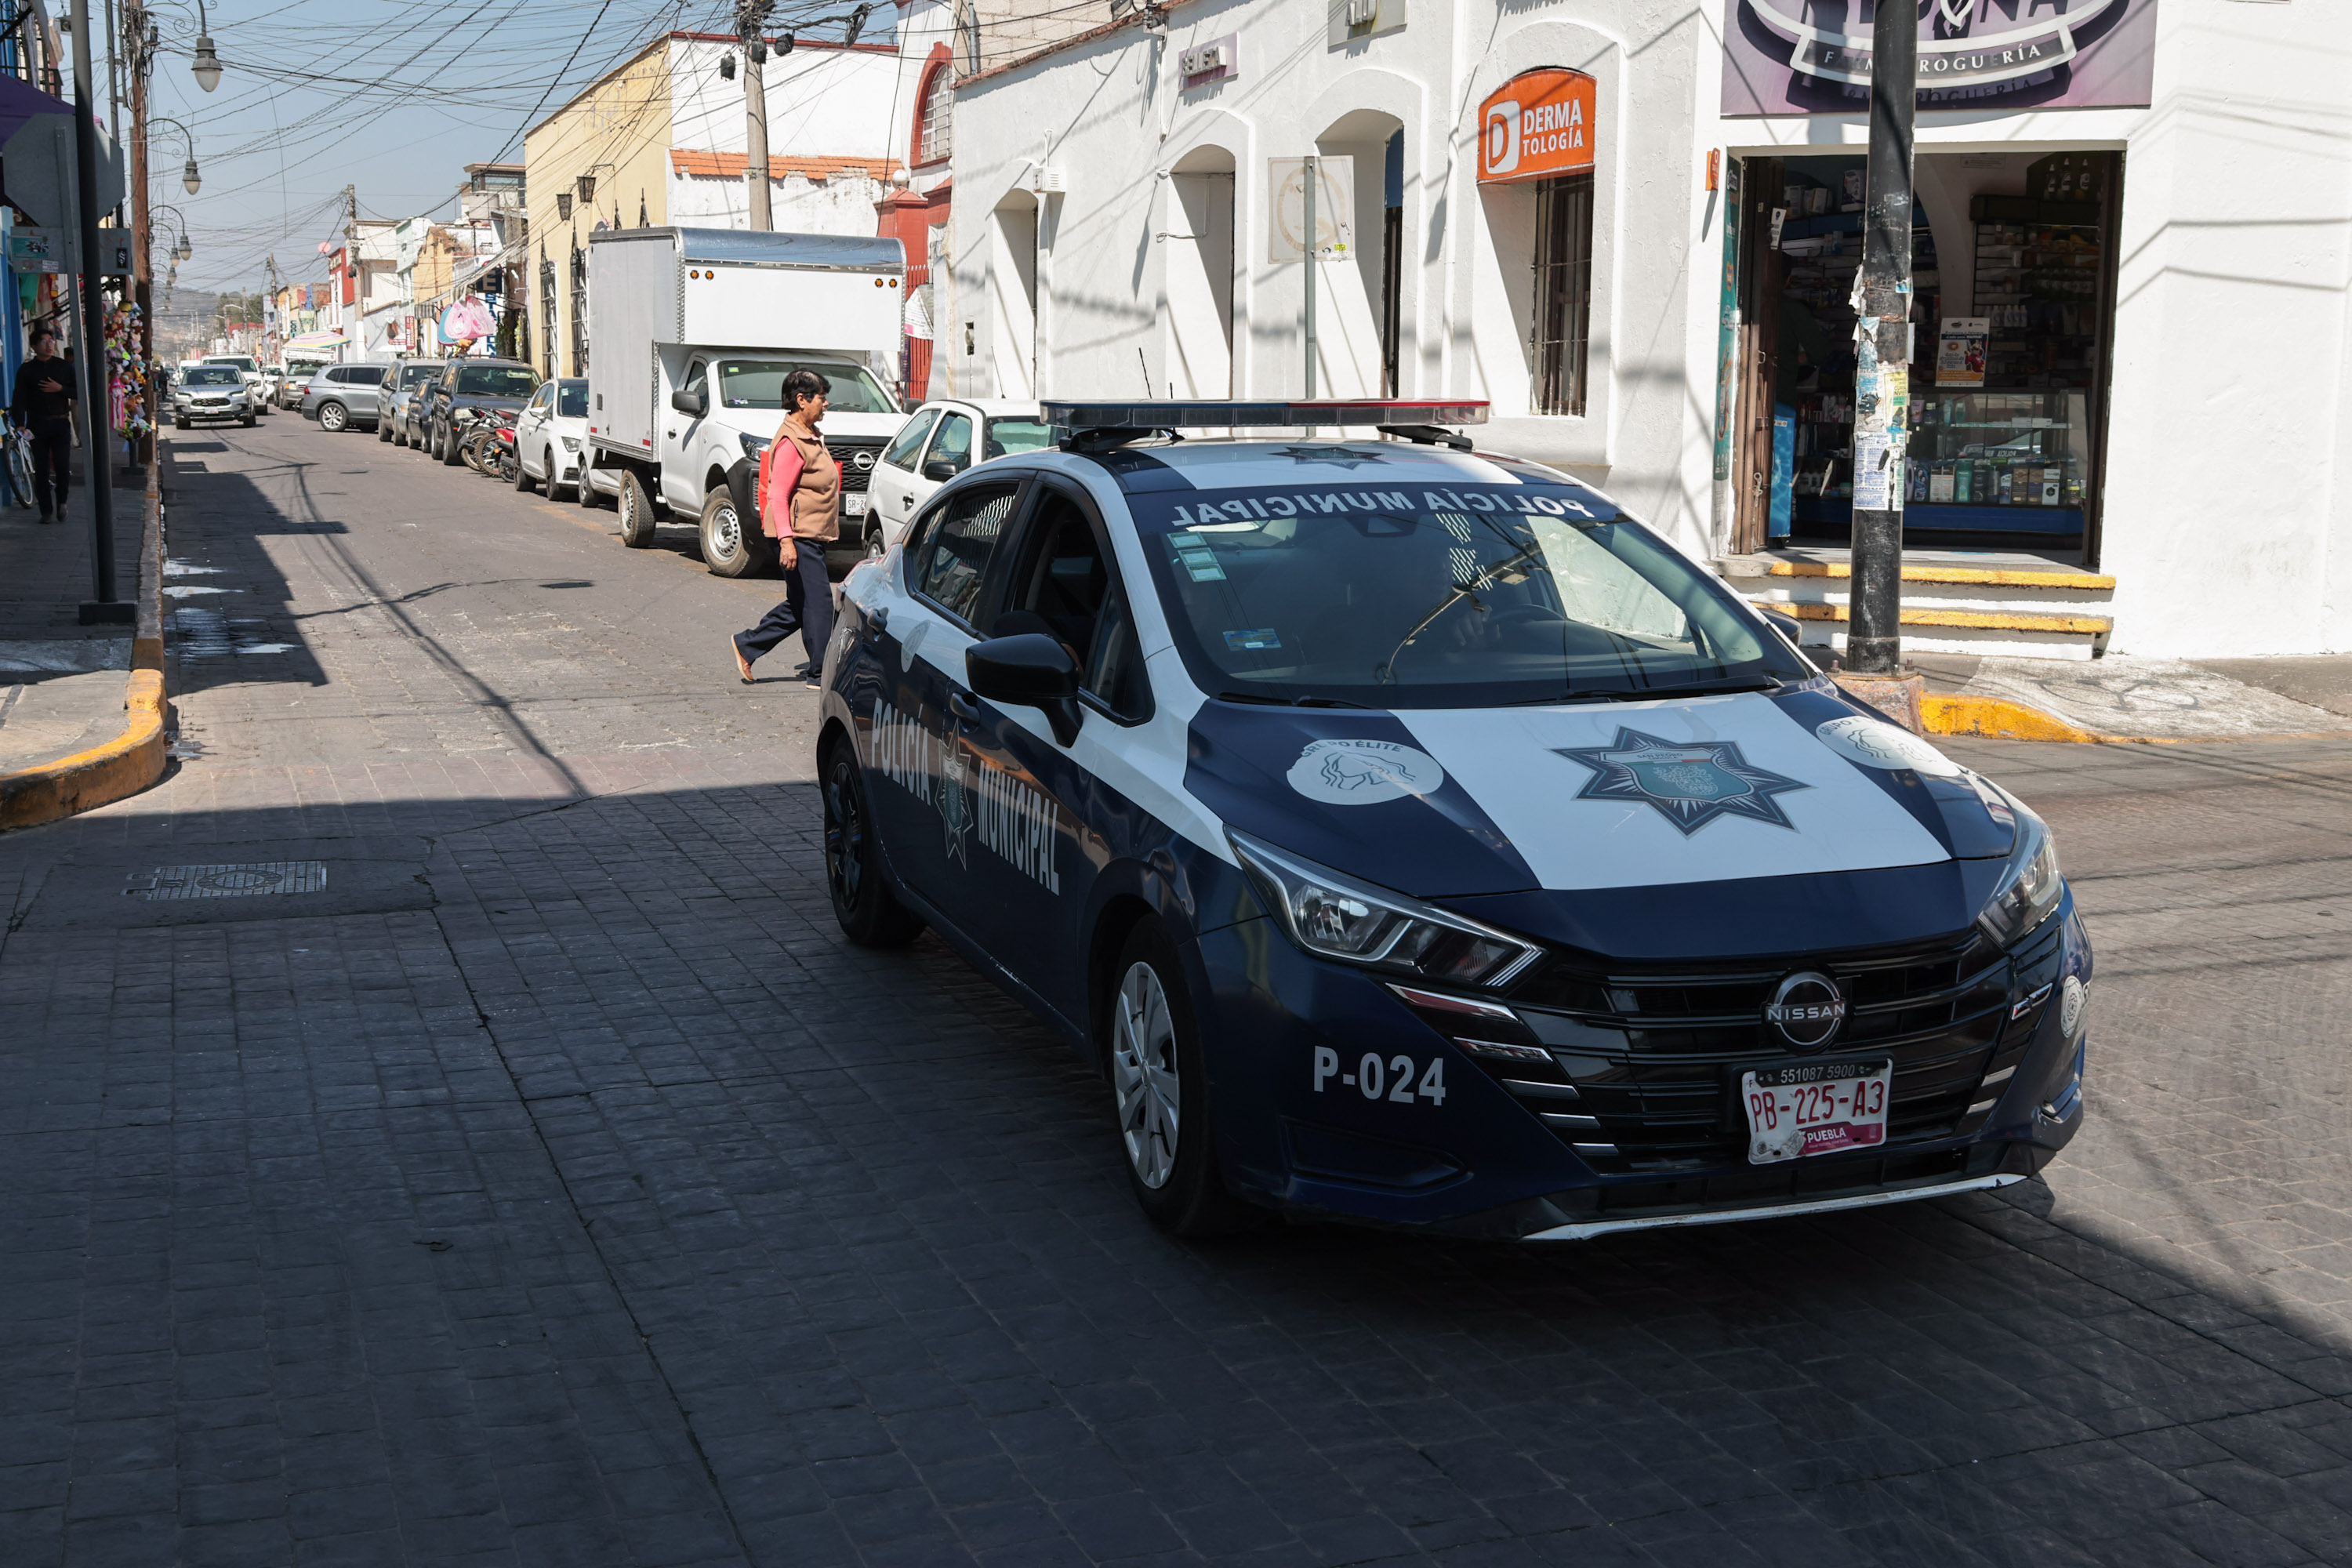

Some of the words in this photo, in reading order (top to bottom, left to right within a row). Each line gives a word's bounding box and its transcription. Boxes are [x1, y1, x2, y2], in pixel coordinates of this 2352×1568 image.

[1523, 98, 1584, 136] DERMA
[1523, 127, 1584, 157] TOLOGÍA
[1817, 720, 1852, 735] GRUPO
[871, 697, 931, 806] POLICÍA
[1355, 739, 1403, 753] ÉLITE
[978, 760, 1059, 896] MUNICIPAL
[1767, 1004, 1846, 1021] NISSAN
[1314, 1045, 1446, 1106] P-024
[1780, 1066, 1824, 1084] 551087
[1827, 1065, 1856, 1079] 5900
[1749, 1079, 1885, 1134] PB-225-A3
[1806, 1127, 1847, 1144] PUEBLA
